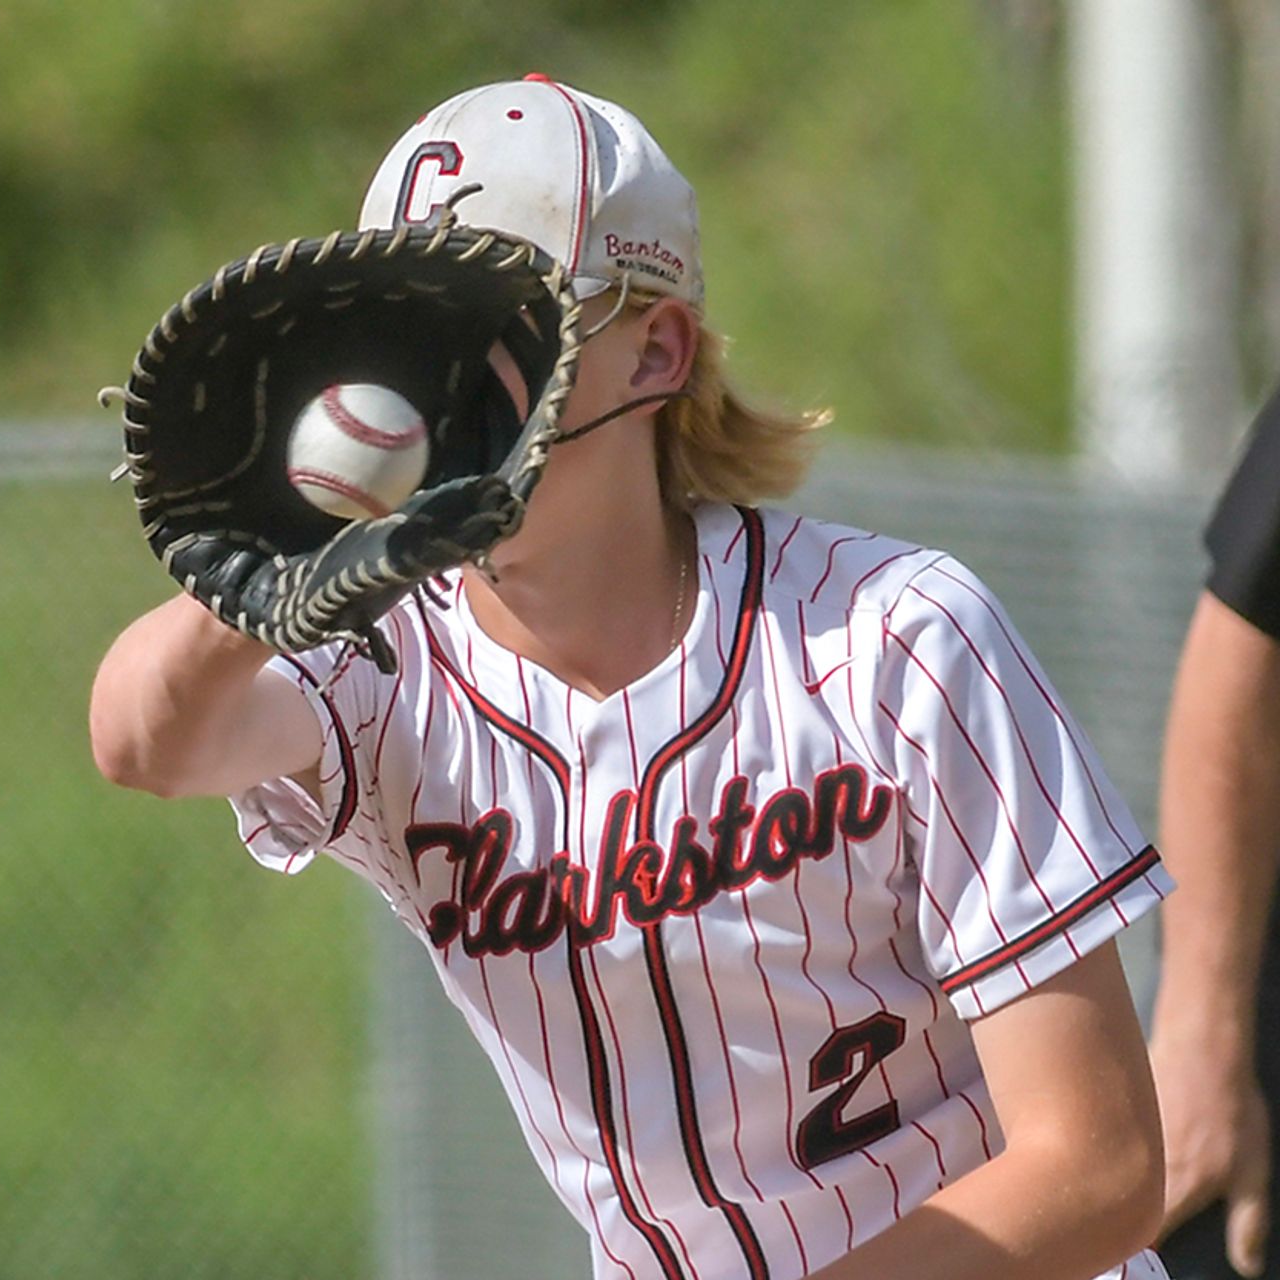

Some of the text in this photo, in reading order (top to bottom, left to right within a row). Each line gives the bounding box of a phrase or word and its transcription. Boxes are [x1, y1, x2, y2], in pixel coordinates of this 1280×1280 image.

[392, 141, 464, 230] C
[604, 233, 684, 274] Bantam
[405, 763, 894, 958] Clarkston
[796, 1011, 906, 1171] 2
